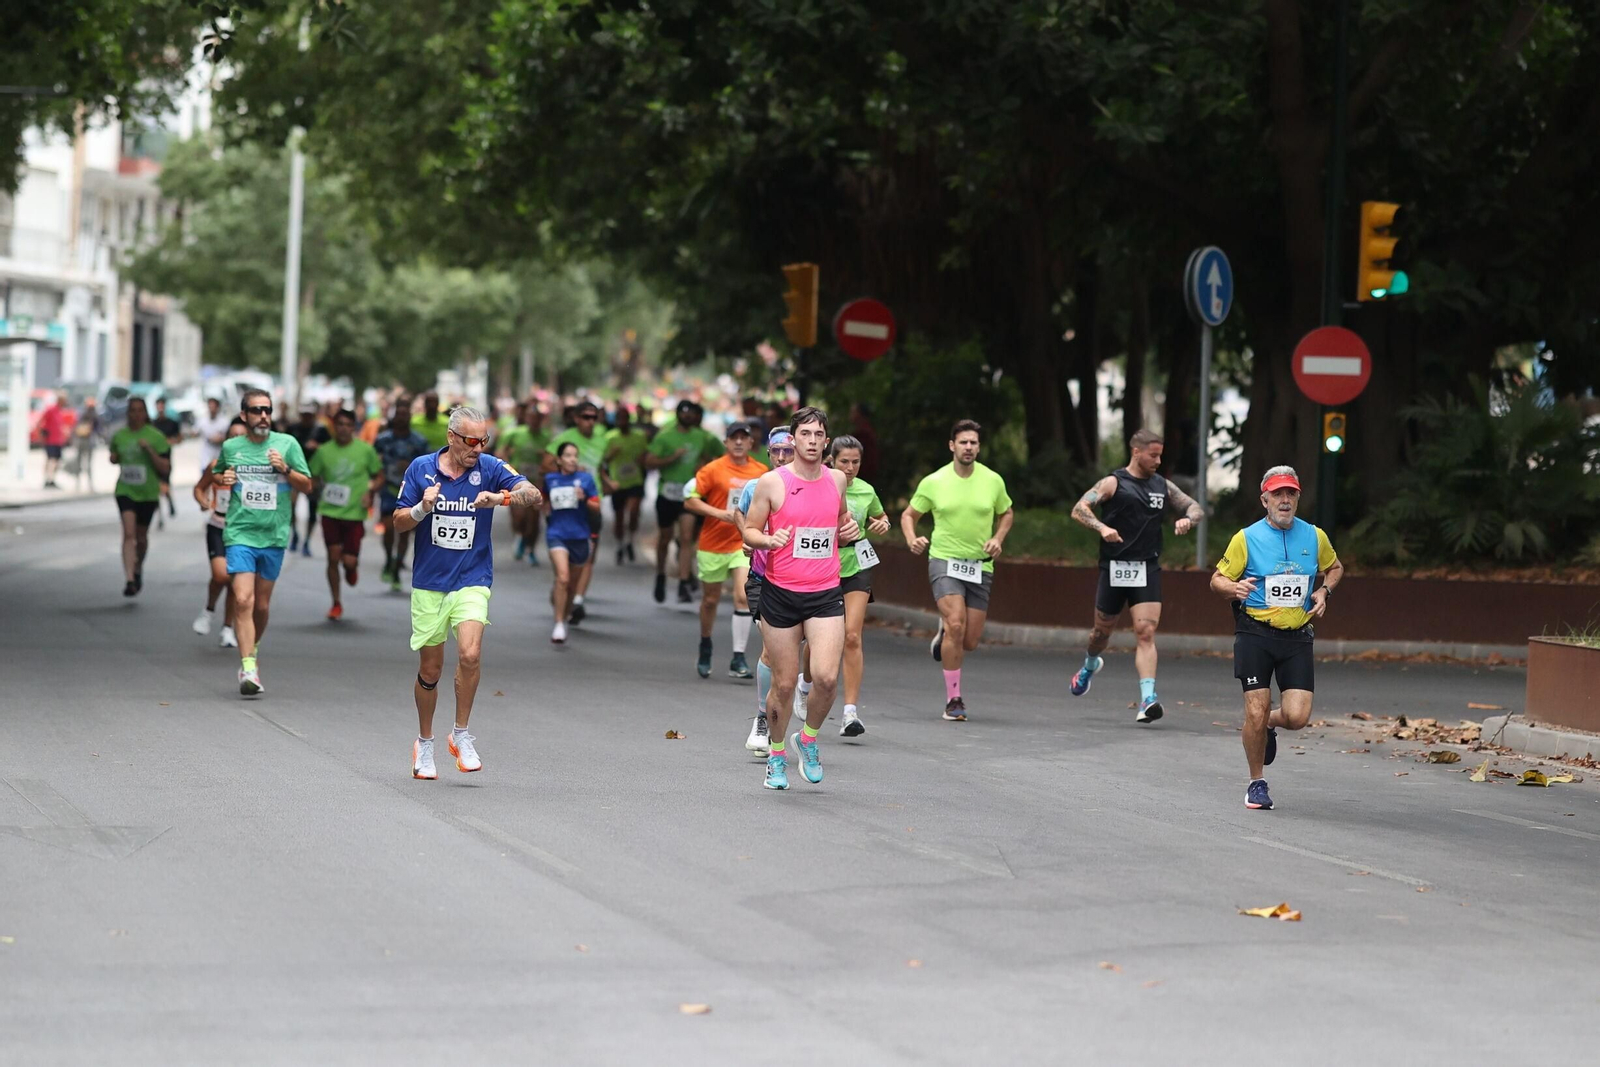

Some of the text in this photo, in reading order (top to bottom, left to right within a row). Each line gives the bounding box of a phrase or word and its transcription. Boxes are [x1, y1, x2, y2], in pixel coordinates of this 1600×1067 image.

[246, 491, 271, 502] 628
[1149, 496, 1164, 509] 33
[437, 526, 468, 540] 673
[800, 537, 829, 550] 564
[952, 563, 975, 576] 998
[1115, 569, 1139, 579] 987
[1271, 585, 1302, 598] 924
